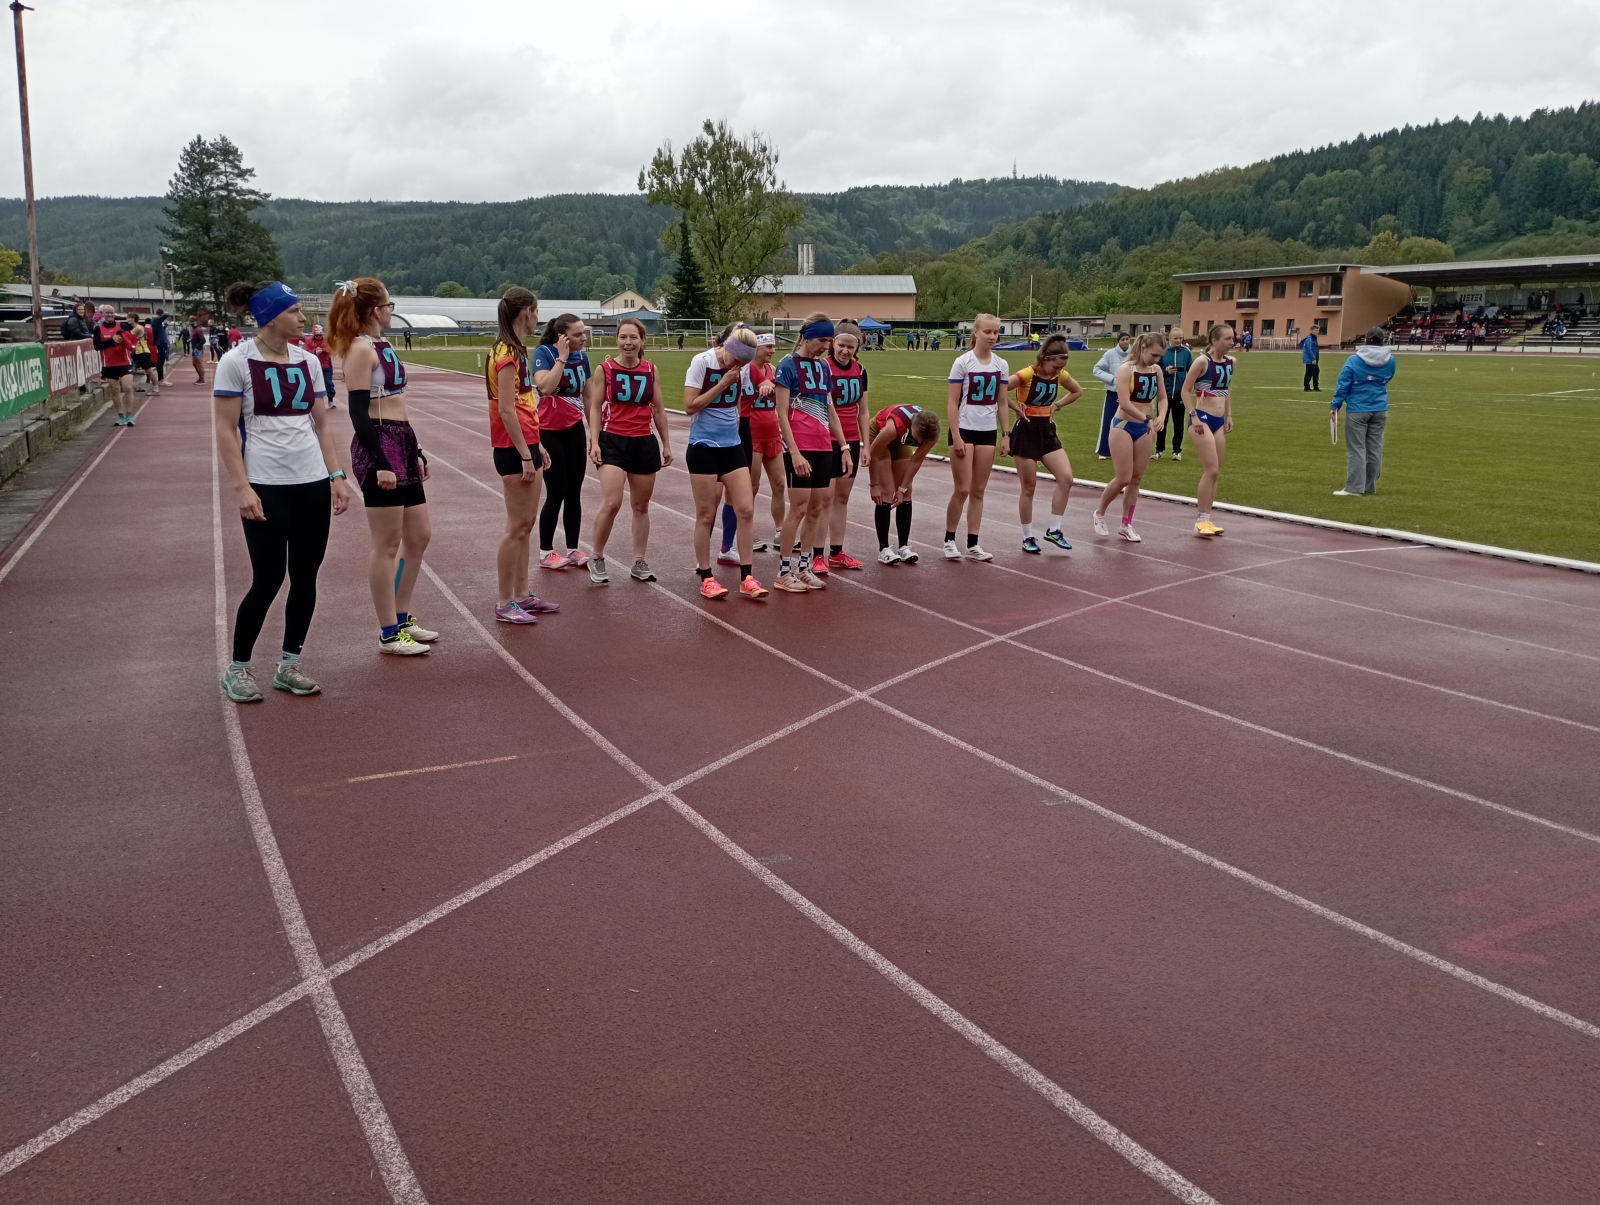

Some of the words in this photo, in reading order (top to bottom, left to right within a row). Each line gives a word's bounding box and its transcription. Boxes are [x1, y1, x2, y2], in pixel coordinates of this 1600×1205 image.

[1460, 293, 1483, 302] RIETER
[15, 357, 44, 397] LANGER
[265, 367, 309, 410] 12
[563, 365, 587, 394] 38
[616, 373, 648, 403] 37
[800, 361, 827, 390] 32
[971, 375, 997, 401] 34
[1137, 375, 1158, 400] 36
[1215, 364, 1233, 388] 26
[836, 378, 861, 406] 30
[1034, 381, 1057, 406] 22
